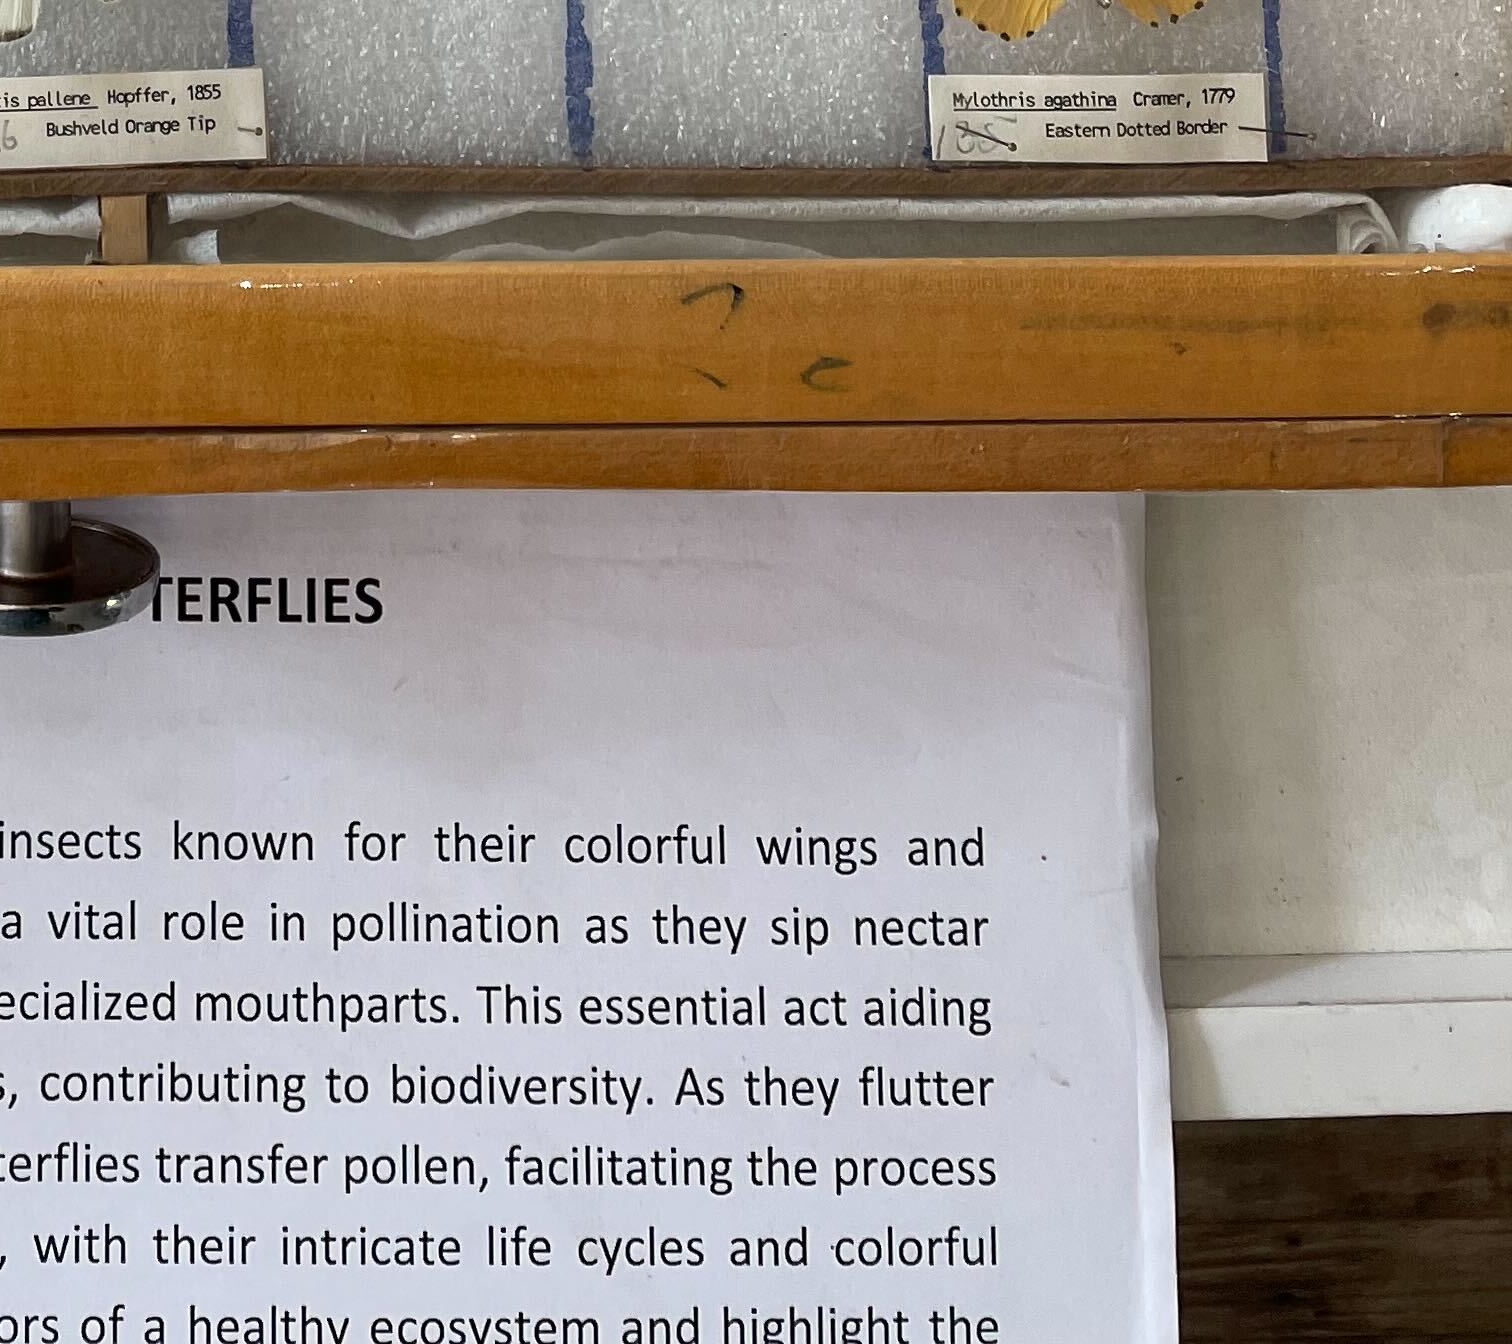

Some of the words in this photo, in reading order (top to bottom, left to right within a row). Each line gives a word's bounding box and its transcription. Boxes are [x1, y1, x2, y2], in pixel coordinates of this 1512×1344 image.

[46, 120, 119, 137] Bushveld
[125, 119, 180, 134] Orange
[188, 116, 216, 132] Tip
[1046, 123, 1111, 138] Eastern
[1117, 122, 1170, 136] Dotted
[1177, 121, 1228, 136] Border
[148, 567, 382, 624] TERFLIES
[174, 820, 313, 860] known
[345, 821, 406, 861] for
[434, 822, 535, 862] their
[565, 824, 725, 864] colorful
[756, 827, 877, 875] wings
[908, 827, 984, 866] and
[41, 1061, 306, 1112] contributing
[325, 1068, 368, 1103] to
[392, 1064, 653, 1115] biodiversity.
[675, 1068, 724, 1105] As
[743, 1056, 839, 1116] they
[859, 1066, 994, 1106] flutter
